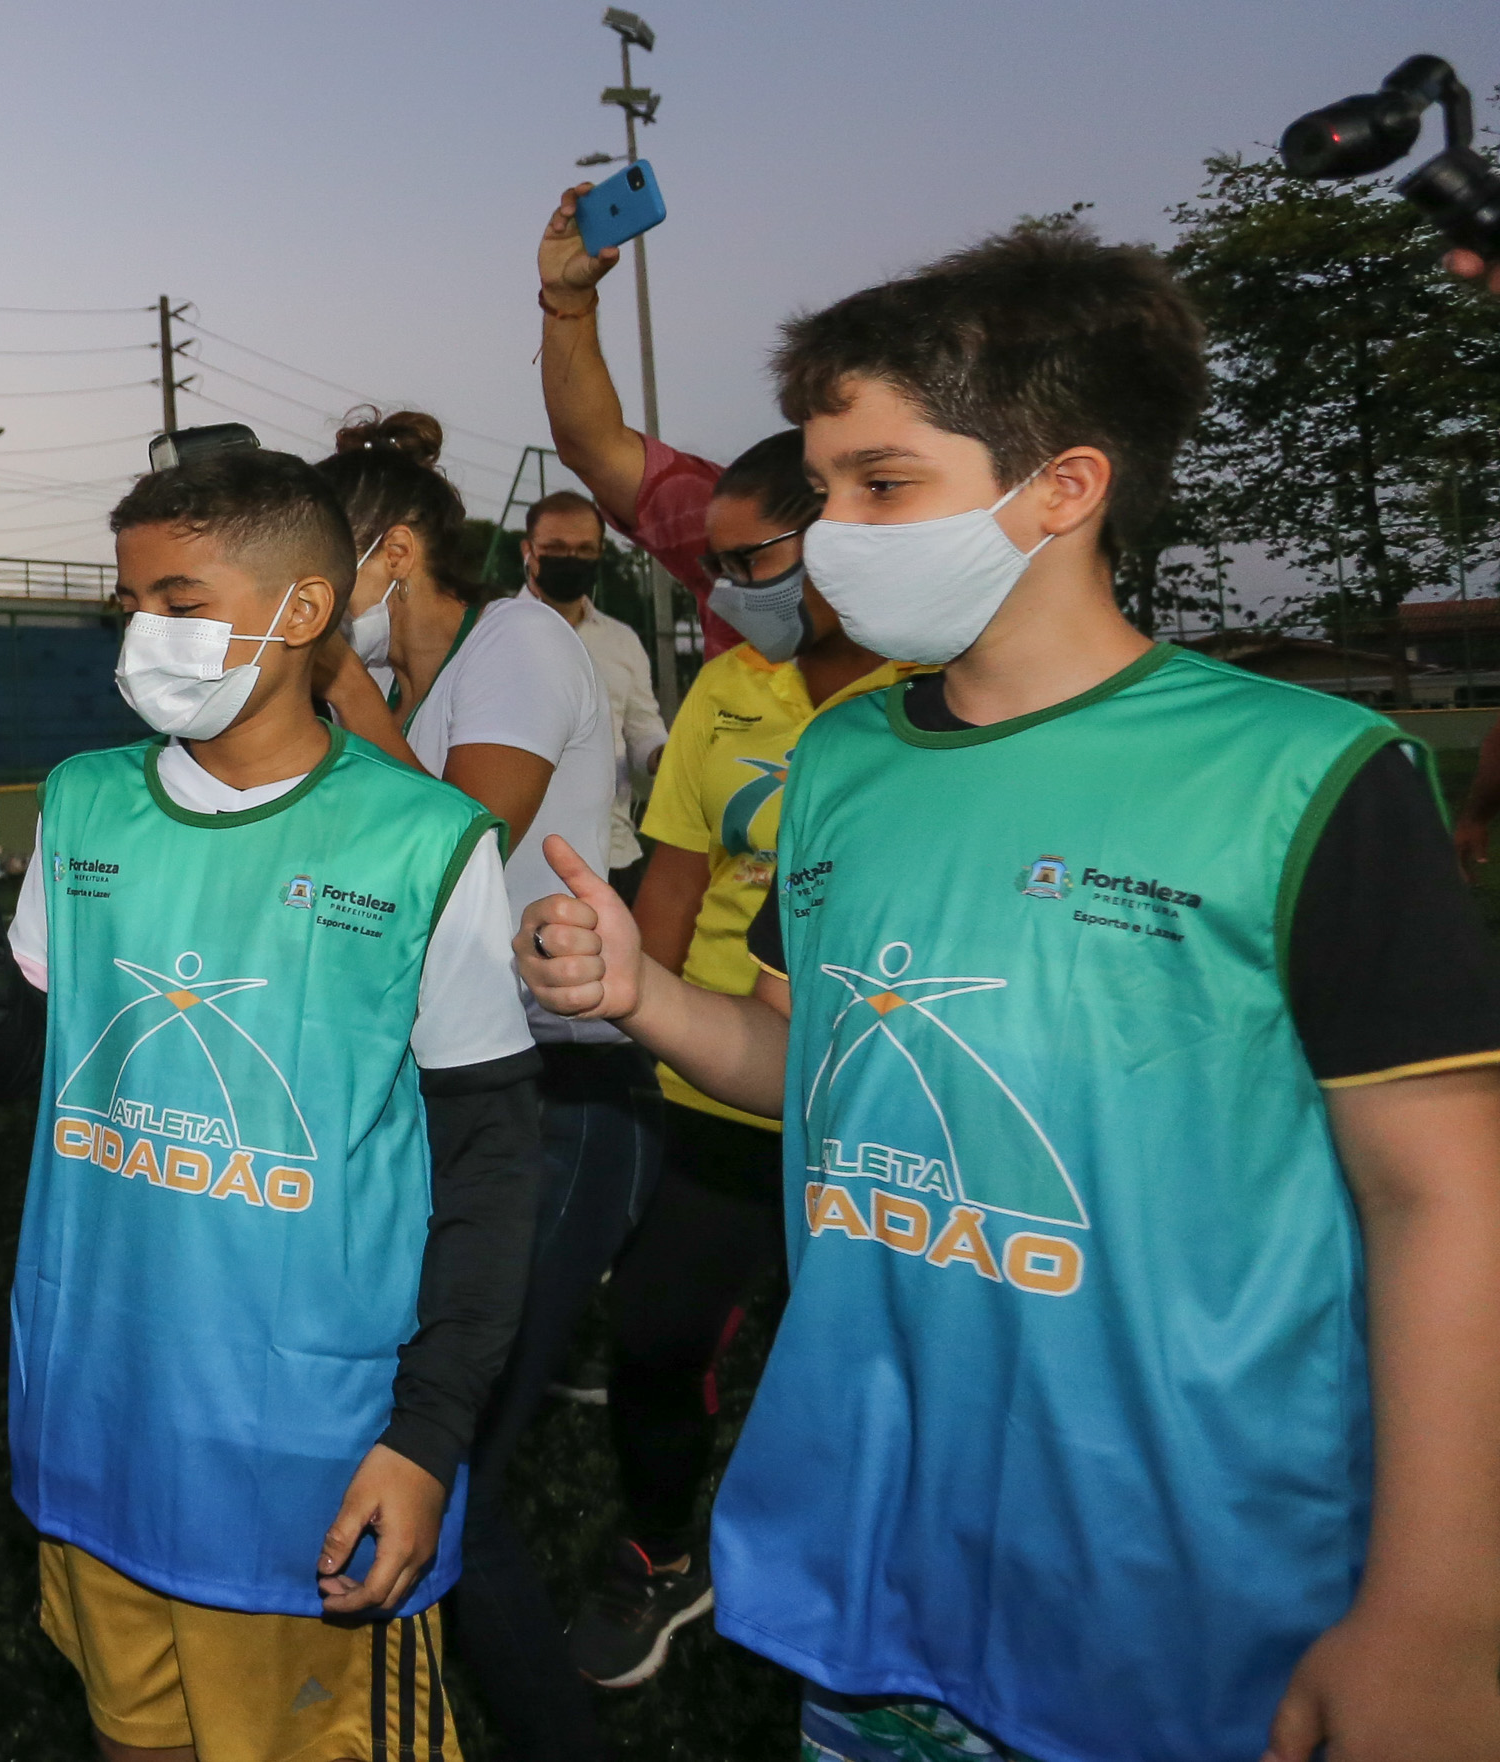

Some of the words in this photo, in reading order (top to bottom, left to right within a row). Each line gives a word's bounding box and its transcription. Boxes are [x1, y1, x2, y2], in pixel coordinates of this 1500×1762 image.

[69, 858, 119, 874] Fortaleza
[322, 884, 396, 913] Fortaleza
[1081, 868, 1202, 909] Fortaleza
[330, 903, 383, 921] PREFEITURA
[1093, 893, 1179, 918] PREFEITURA
[316, 916, 351, 930] Esporte
[360, 926, 383, 938] Lazer
[1073, 910, 1129, 930] Esporte
[1132, 925, 1141, 933] e
[1146, 924, 1184, 942] Lazer
[111, 1097, 233, 1149] ATLETA
[54, 1117, 314, 1212] CIDADÃO
[822, 1138, 954, 1202] LETA
[805, 1181, 1084, 1296] ADÃO
